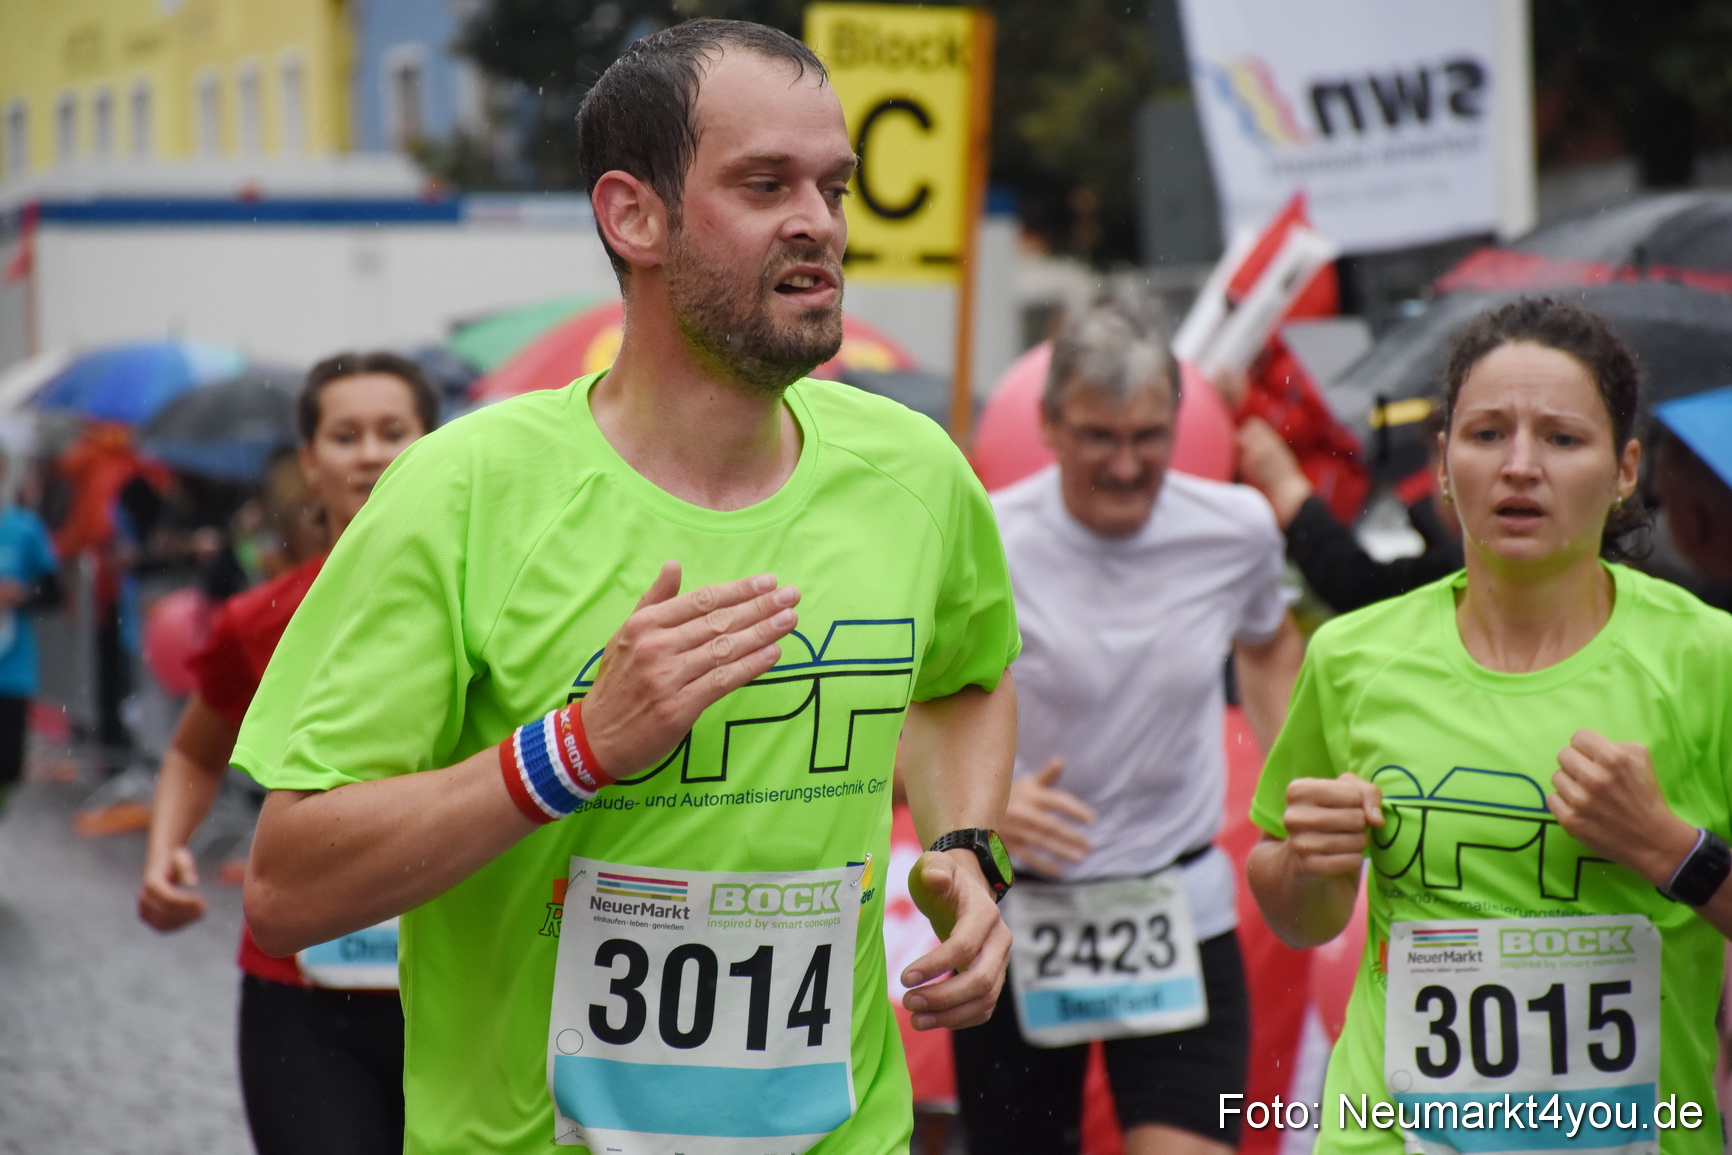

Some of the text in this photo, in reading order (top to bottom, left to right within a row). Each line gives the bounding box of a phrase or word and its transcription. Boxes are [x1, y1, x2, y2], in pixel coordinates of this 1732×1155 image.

[855, 97, 931, 221] C
[574, 795, 640, 813] ebäude-
[645, 793, 677, 808] und
[680, 780, 865, 808] Automatisierungstechnik
[589, 896, 691, 920] NeuerMarkt
[708, 880, 843, 917] BOCK
[707, 916, 841, 931] inspired by smart concepts
[1032, 913, 1177, 978] 2423
[1407, 949, 1484, 965] NeuerMarkt
[1499, 926, 1635, 958] BOCK
[589, 938, 832, 1051] 3014
[1415, 980, 1637, 1079] 3015
